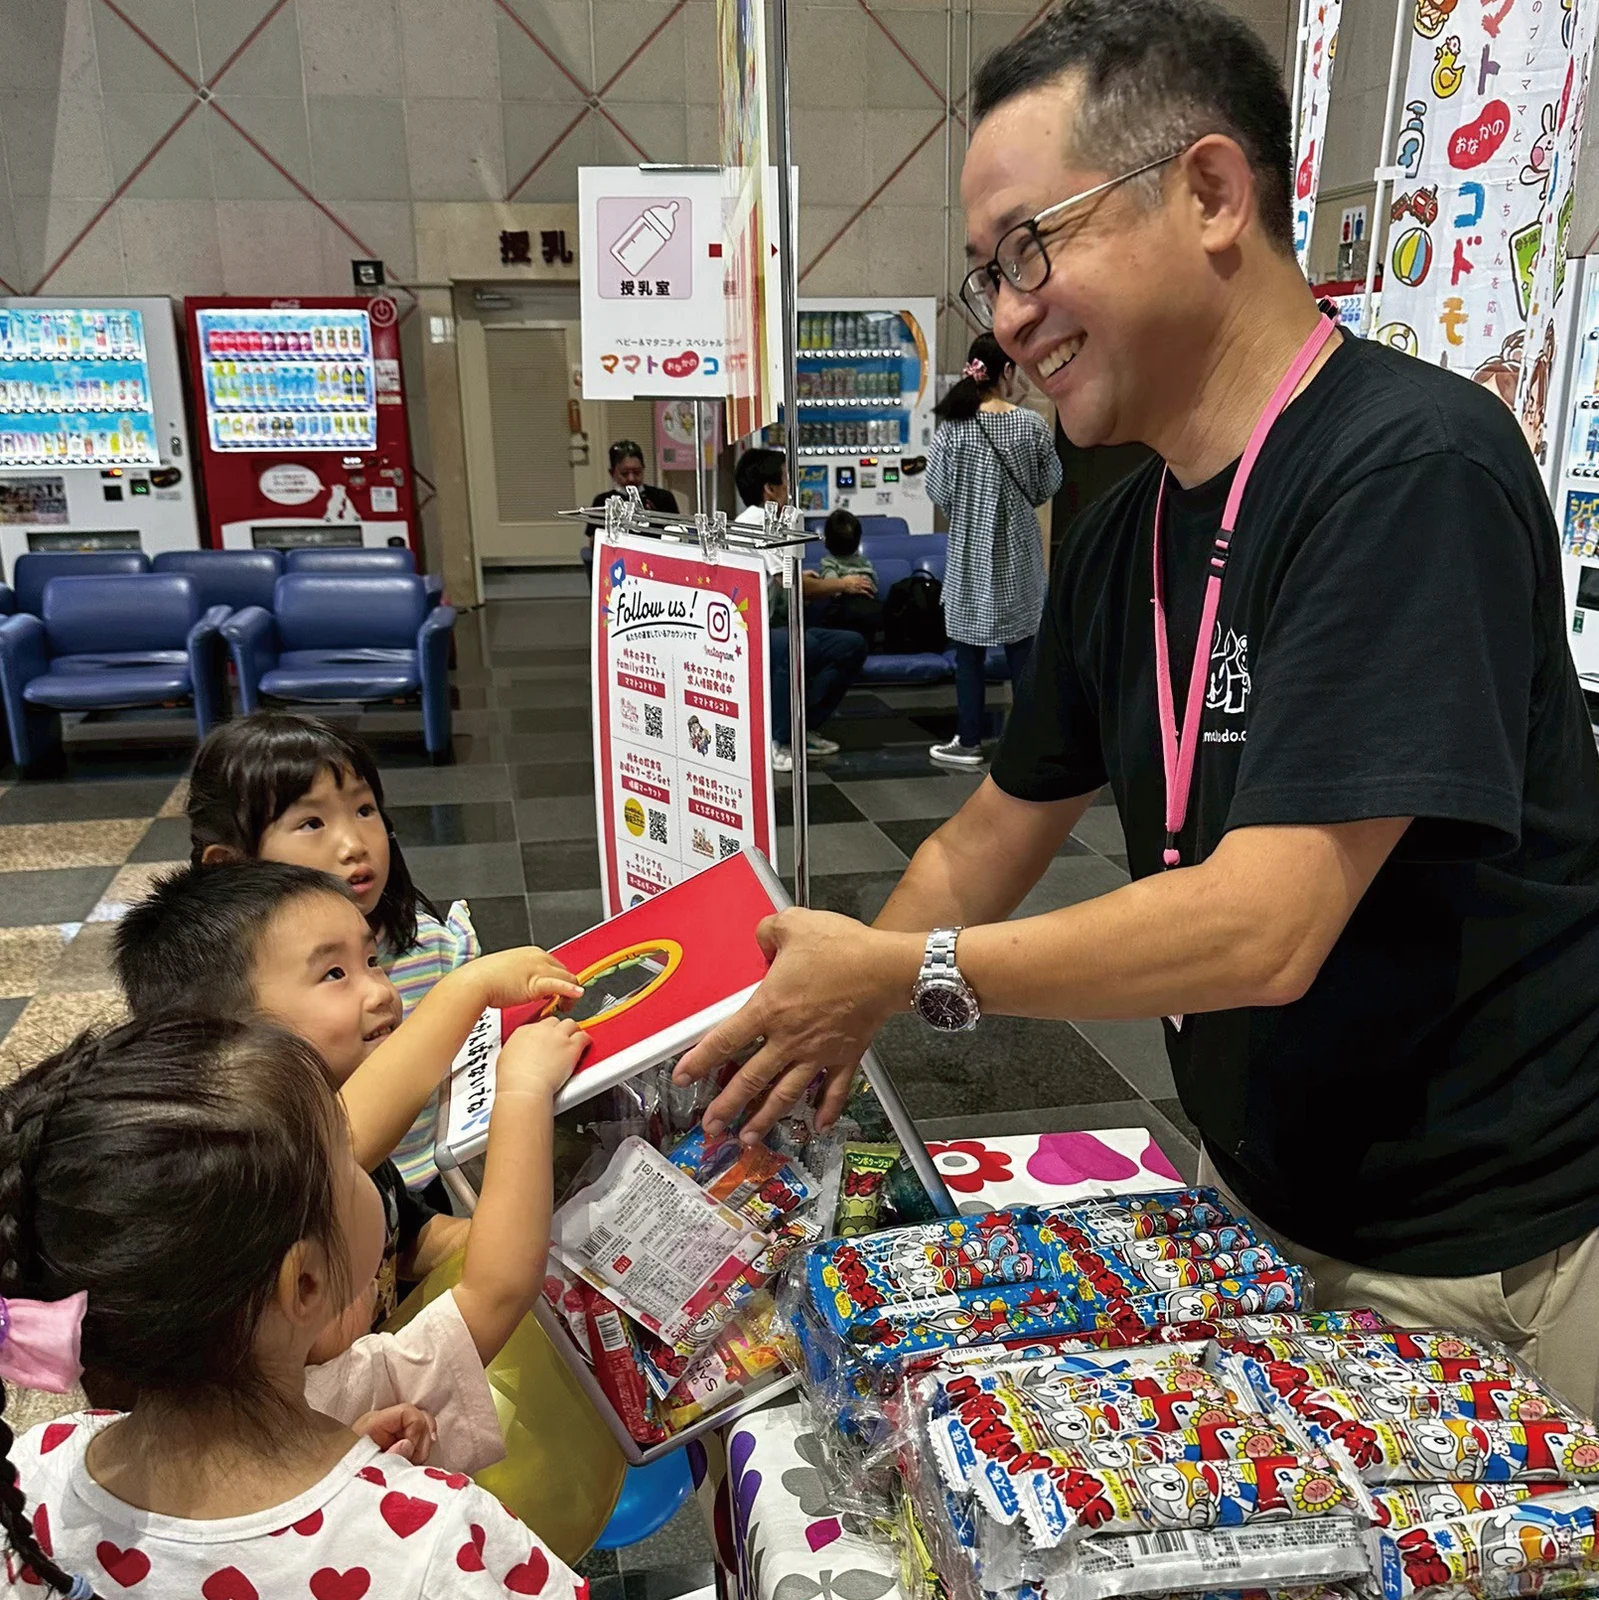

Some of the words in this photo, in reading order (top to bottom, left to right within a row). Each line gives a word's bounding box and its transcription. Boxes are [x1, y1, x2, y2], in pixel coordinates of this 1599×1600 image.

[1455, 119, 1505, 154] おなかの
[620, 280, 671, 296] 授乳室
[686, 339, 724, 347] スペシャル
[617, 591, 665, 626] Follow
[704, 645, 735, 663] Instagram
[1383, 1543, 1398, 1594] チーズ味
